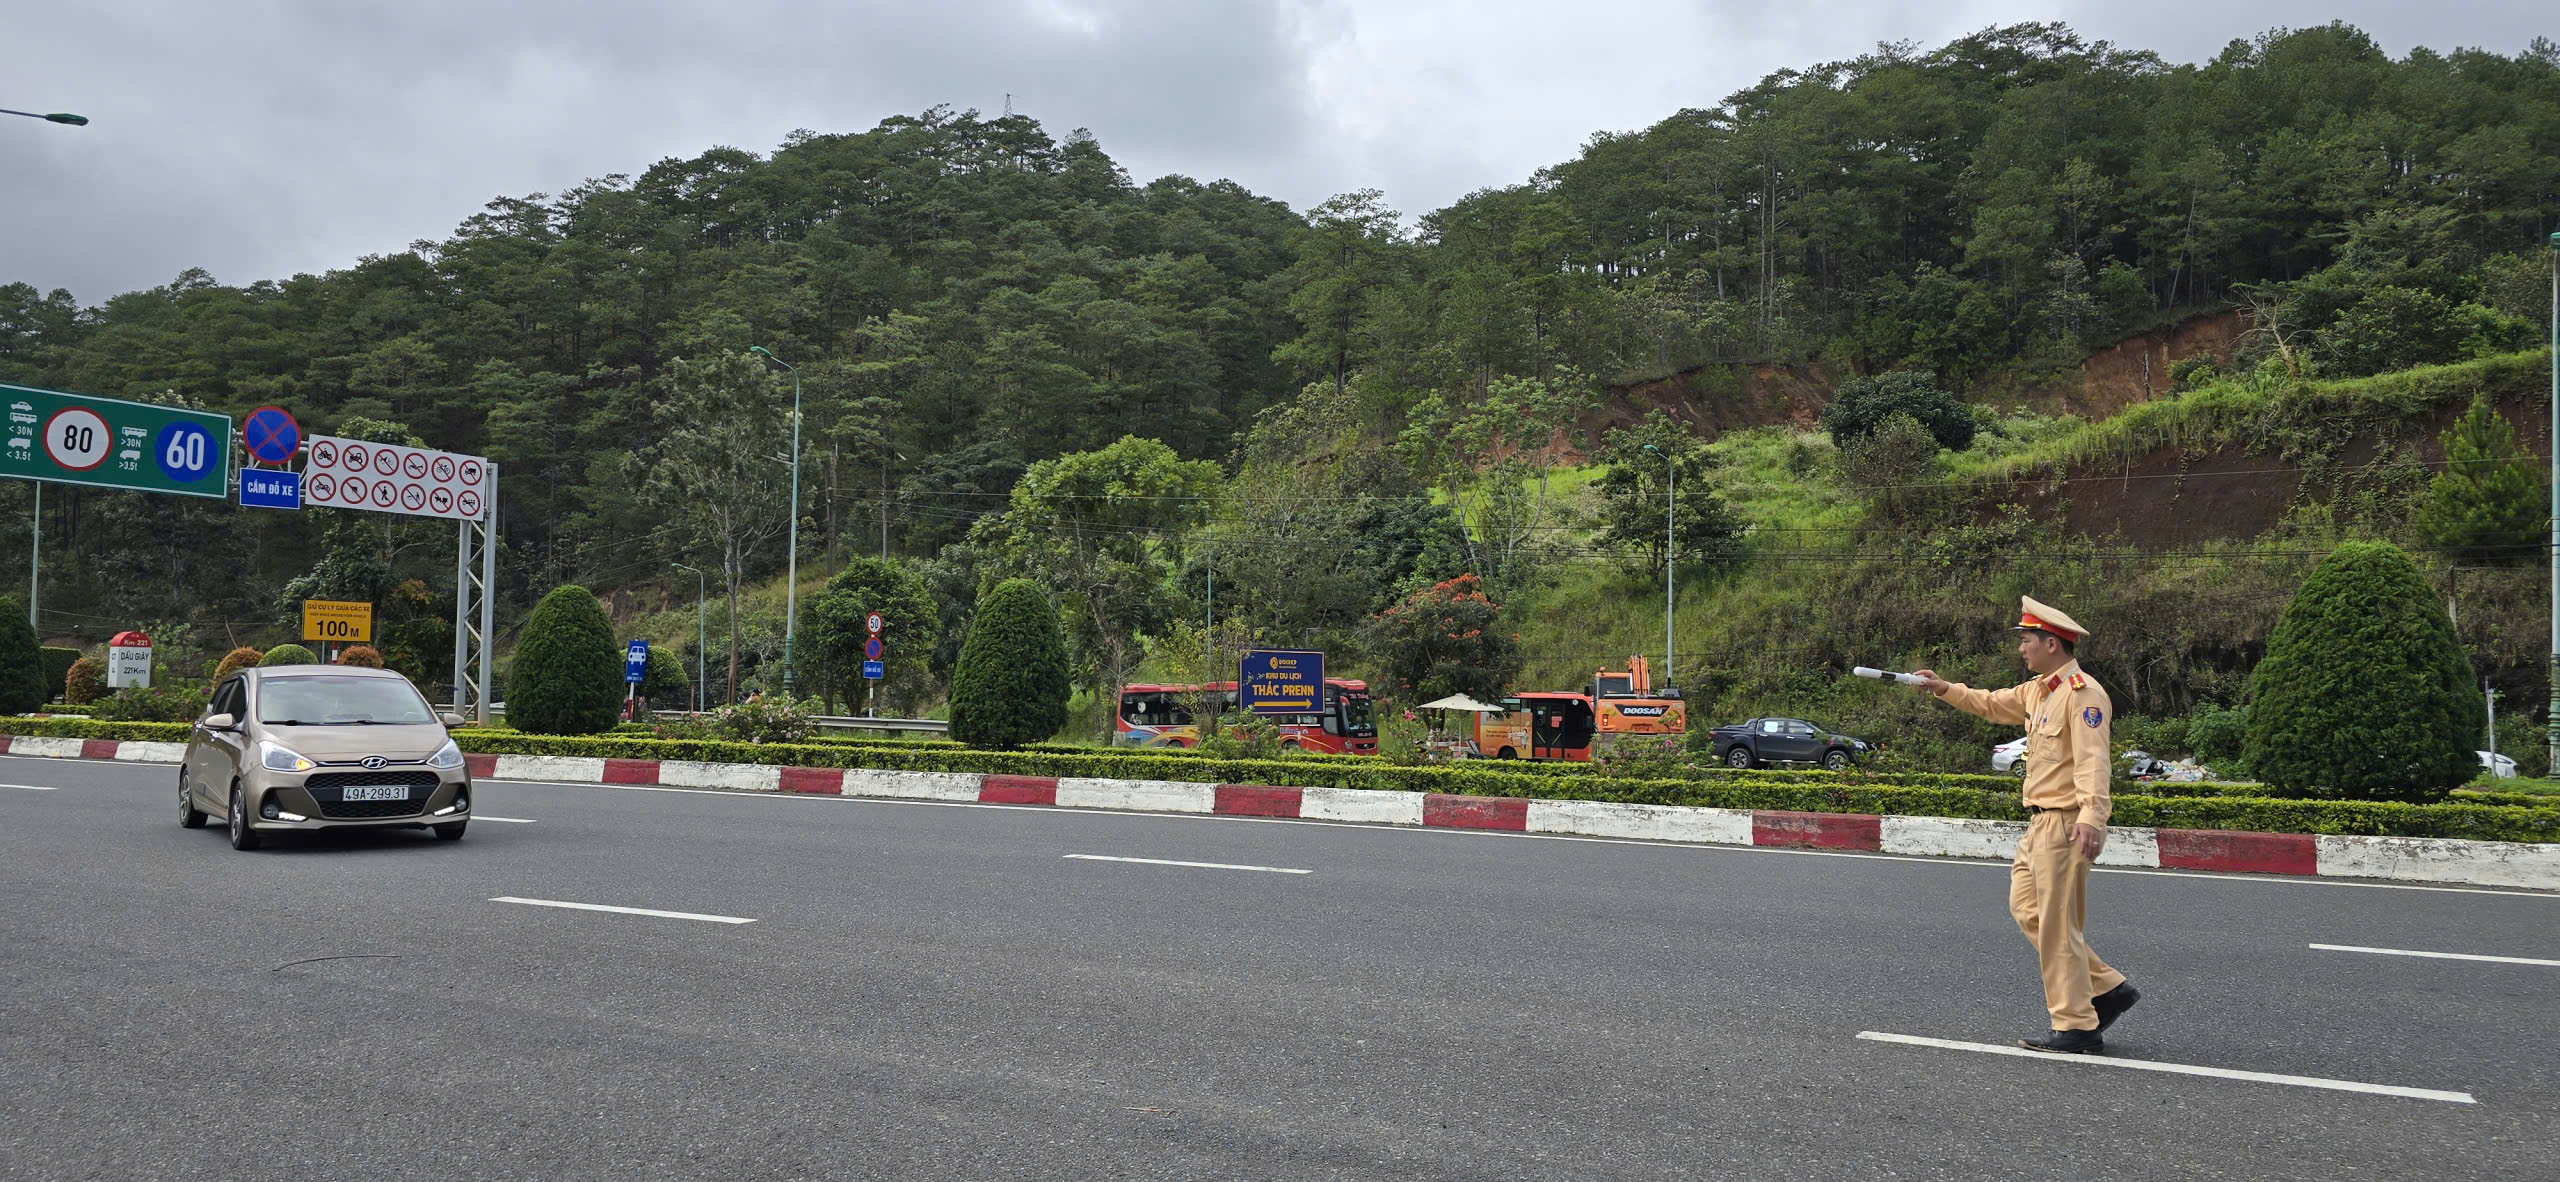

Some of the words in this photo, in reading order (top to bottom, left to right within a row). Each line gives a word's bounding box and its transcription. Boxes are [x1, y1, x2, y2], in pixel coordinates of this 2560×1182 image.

[16, 426, 33, 436] 30N
[63, 424, 93, 454] 80
[15, 450, 31, 461] 3.5t
[166, 430, 205, 471] 60
[268, 480, 280, 495] ĐỖ
[281, 484, 294, 496] XE
[316, 620, 348, 636] 100
[350, 627, 359, 638] M
[870, 618, 879, 629] 50
[1265, 672, 1279, 680] KHU
[1279, 672, 1288, 680] DU
[1252, 681, 1279, 696] THÁC
[1282, 685, 1314, 696] PRENN
[1623, 707, 1663, 715] DOOSAN
[345, 787, 406, 799] 49A-299.31
